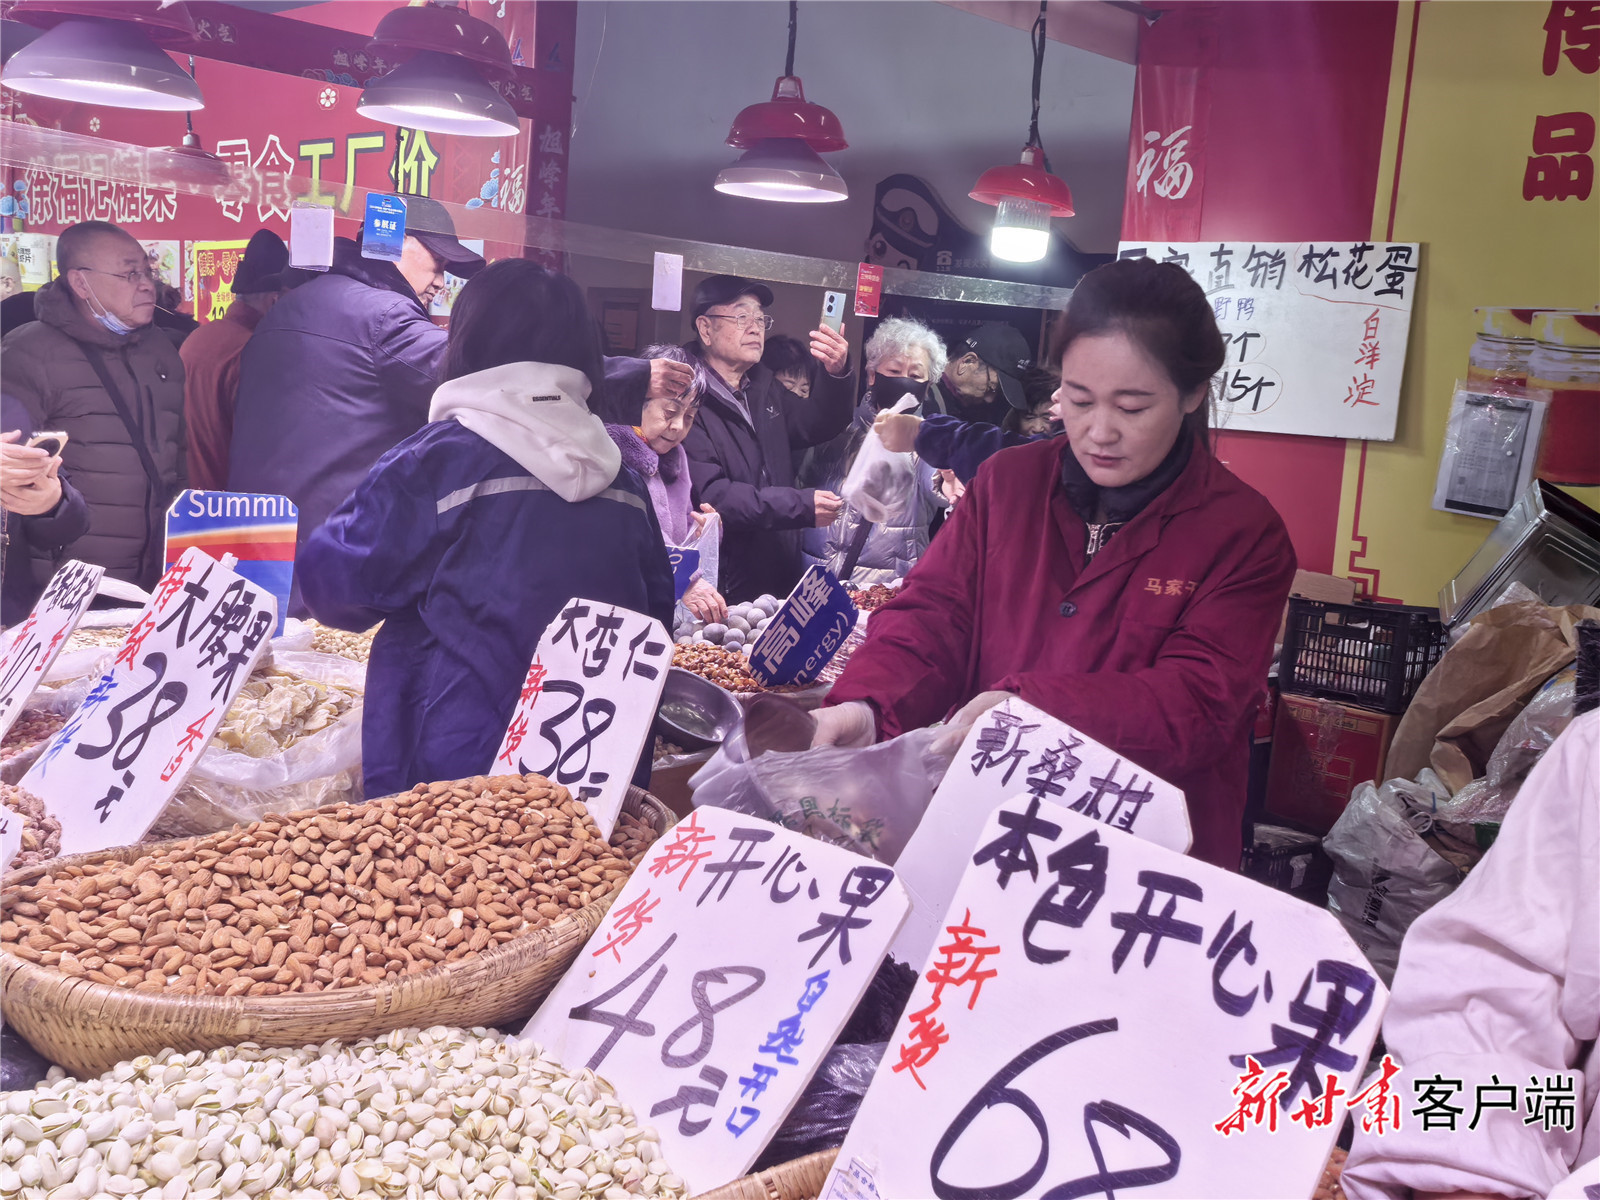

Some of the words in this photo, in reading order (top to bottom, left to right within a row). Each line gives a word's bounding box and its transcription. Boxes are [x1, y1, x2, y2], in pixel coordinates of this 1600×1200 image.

[500, 163, 526, 215] 福
[1136, 125, 1194, 200] 福
[1522, 112, 1596, 202] 品
[1297, 242, 1418, 300] 松花蛋
[1342, 307, 1381, 408] 白洋淀
[156, 561, 273, 706] 大腰果
[551, 598, 667, 682] 大杏仁
[696, 826, 895, 971] 开心果
[972, 796, 1377, 1112] 本色开心果
